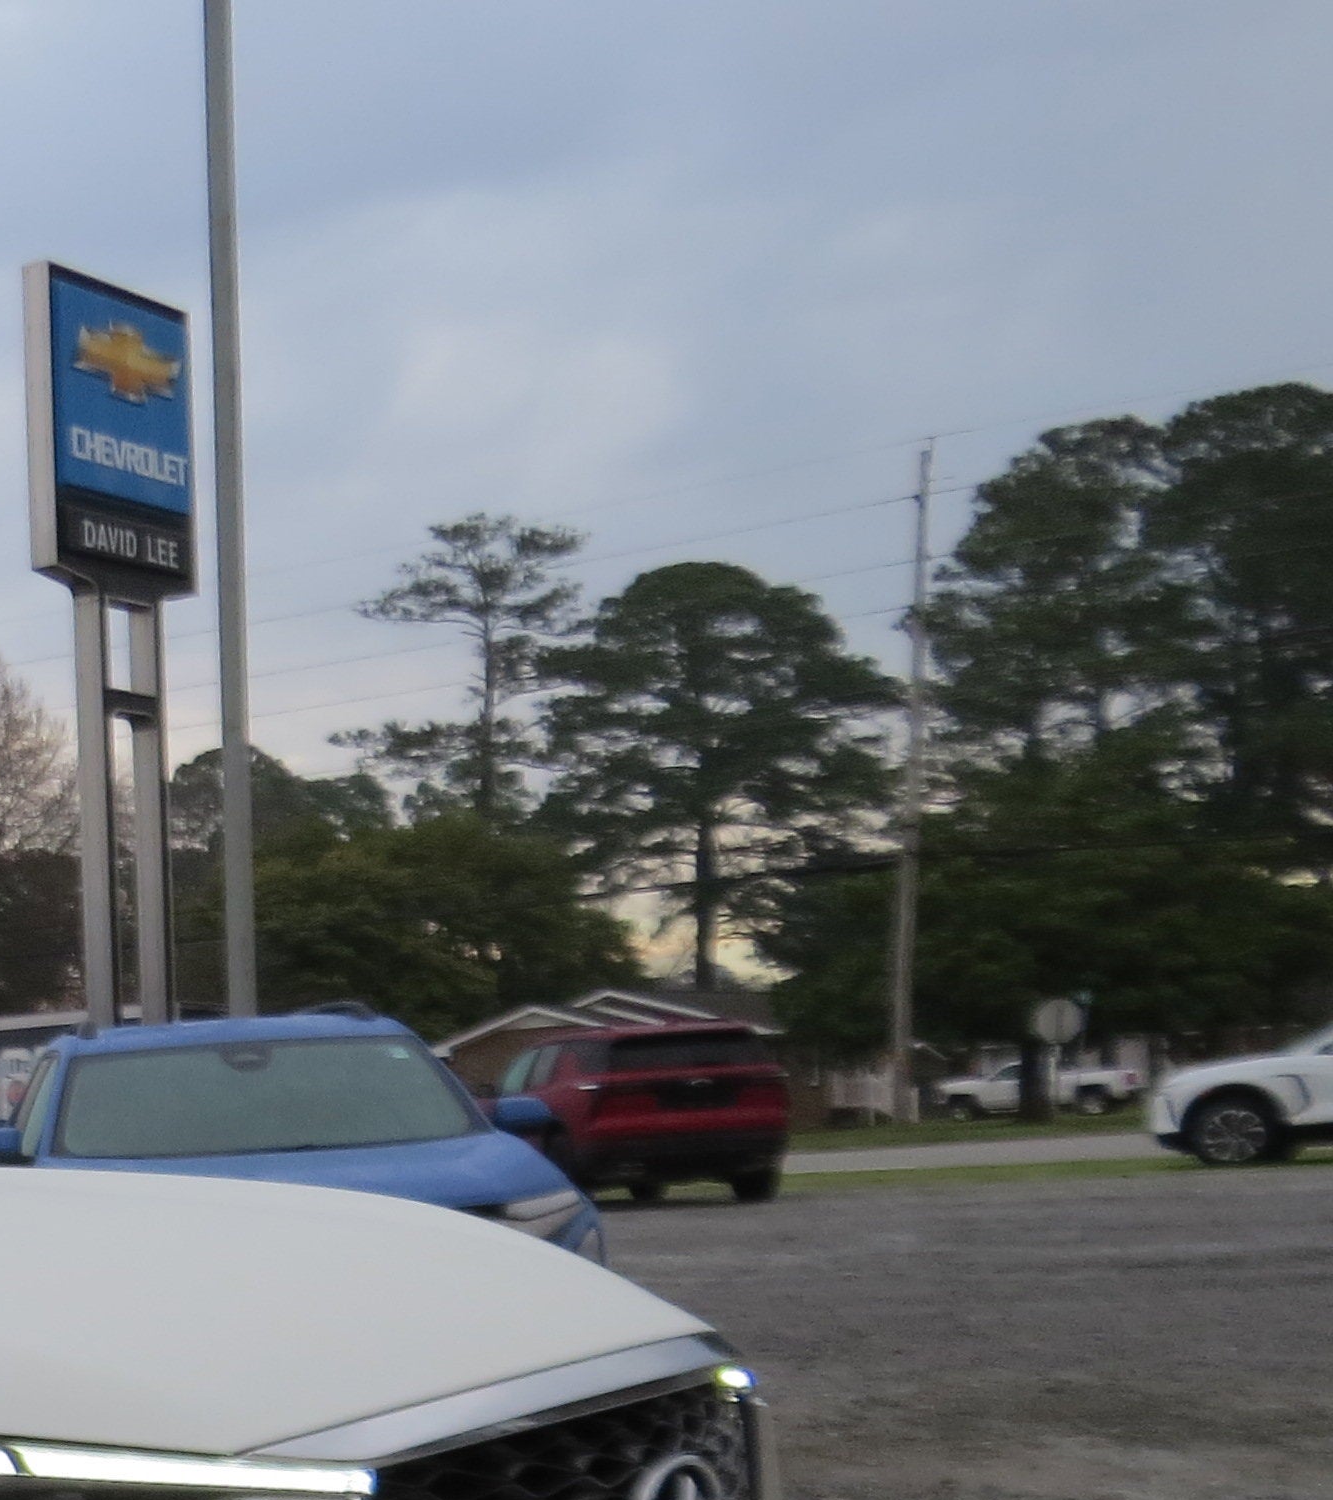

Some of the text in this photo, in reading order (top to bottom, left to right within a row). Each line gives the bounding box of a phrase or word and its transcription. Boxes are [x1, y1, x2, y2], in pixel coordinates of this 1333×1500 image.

[70, 426, 188, 486] CHEVROLET
[83, 519, 179, 569] DAVID LEE
